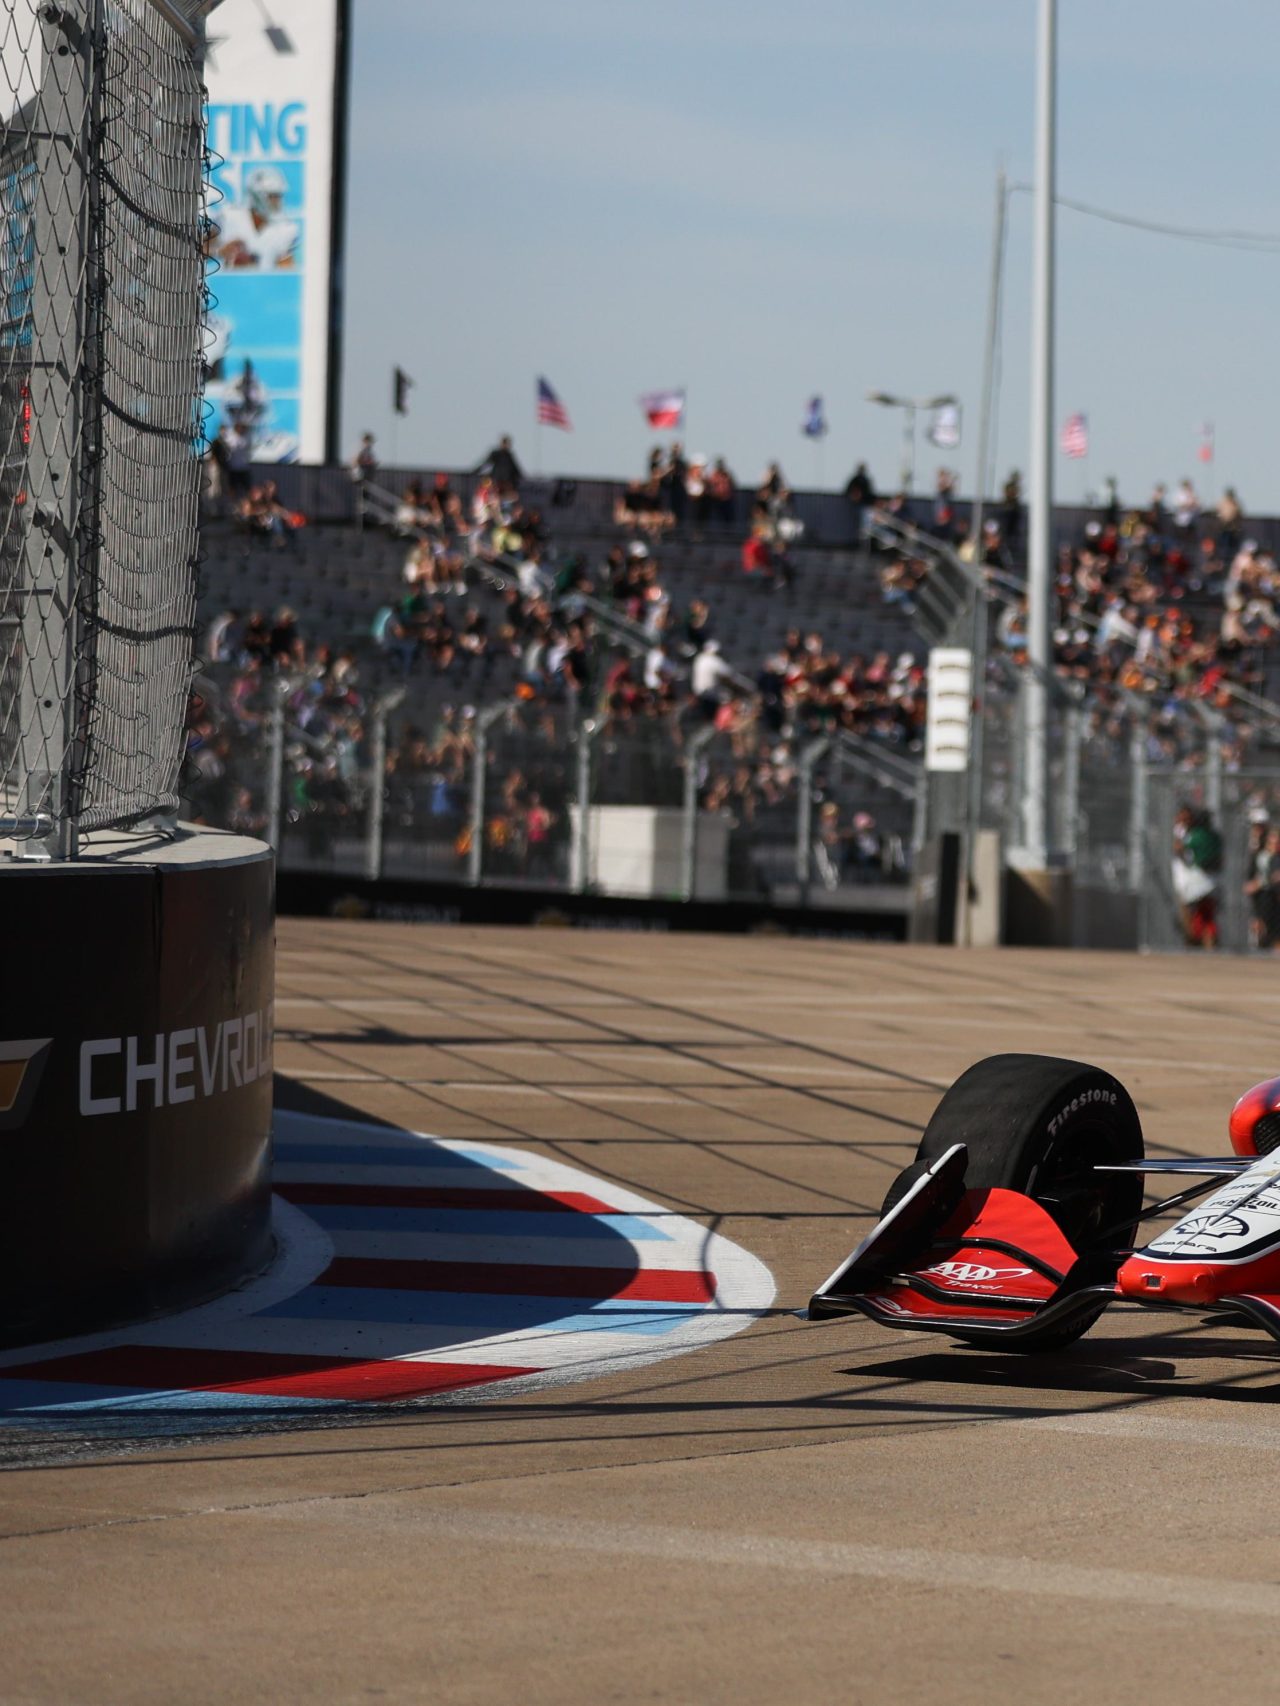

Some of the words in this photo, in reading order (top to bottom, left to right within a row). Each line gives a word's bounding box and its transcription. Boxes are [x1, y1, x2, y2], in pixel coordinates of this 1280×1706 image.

[1047, 1089, 1117, 1137] Firestone
[1208, 1196, 1280, 1212] PENZOIL
[930, 1261, 997, 1281] AAA
[945, 1279, 1004, 1290] Travel
